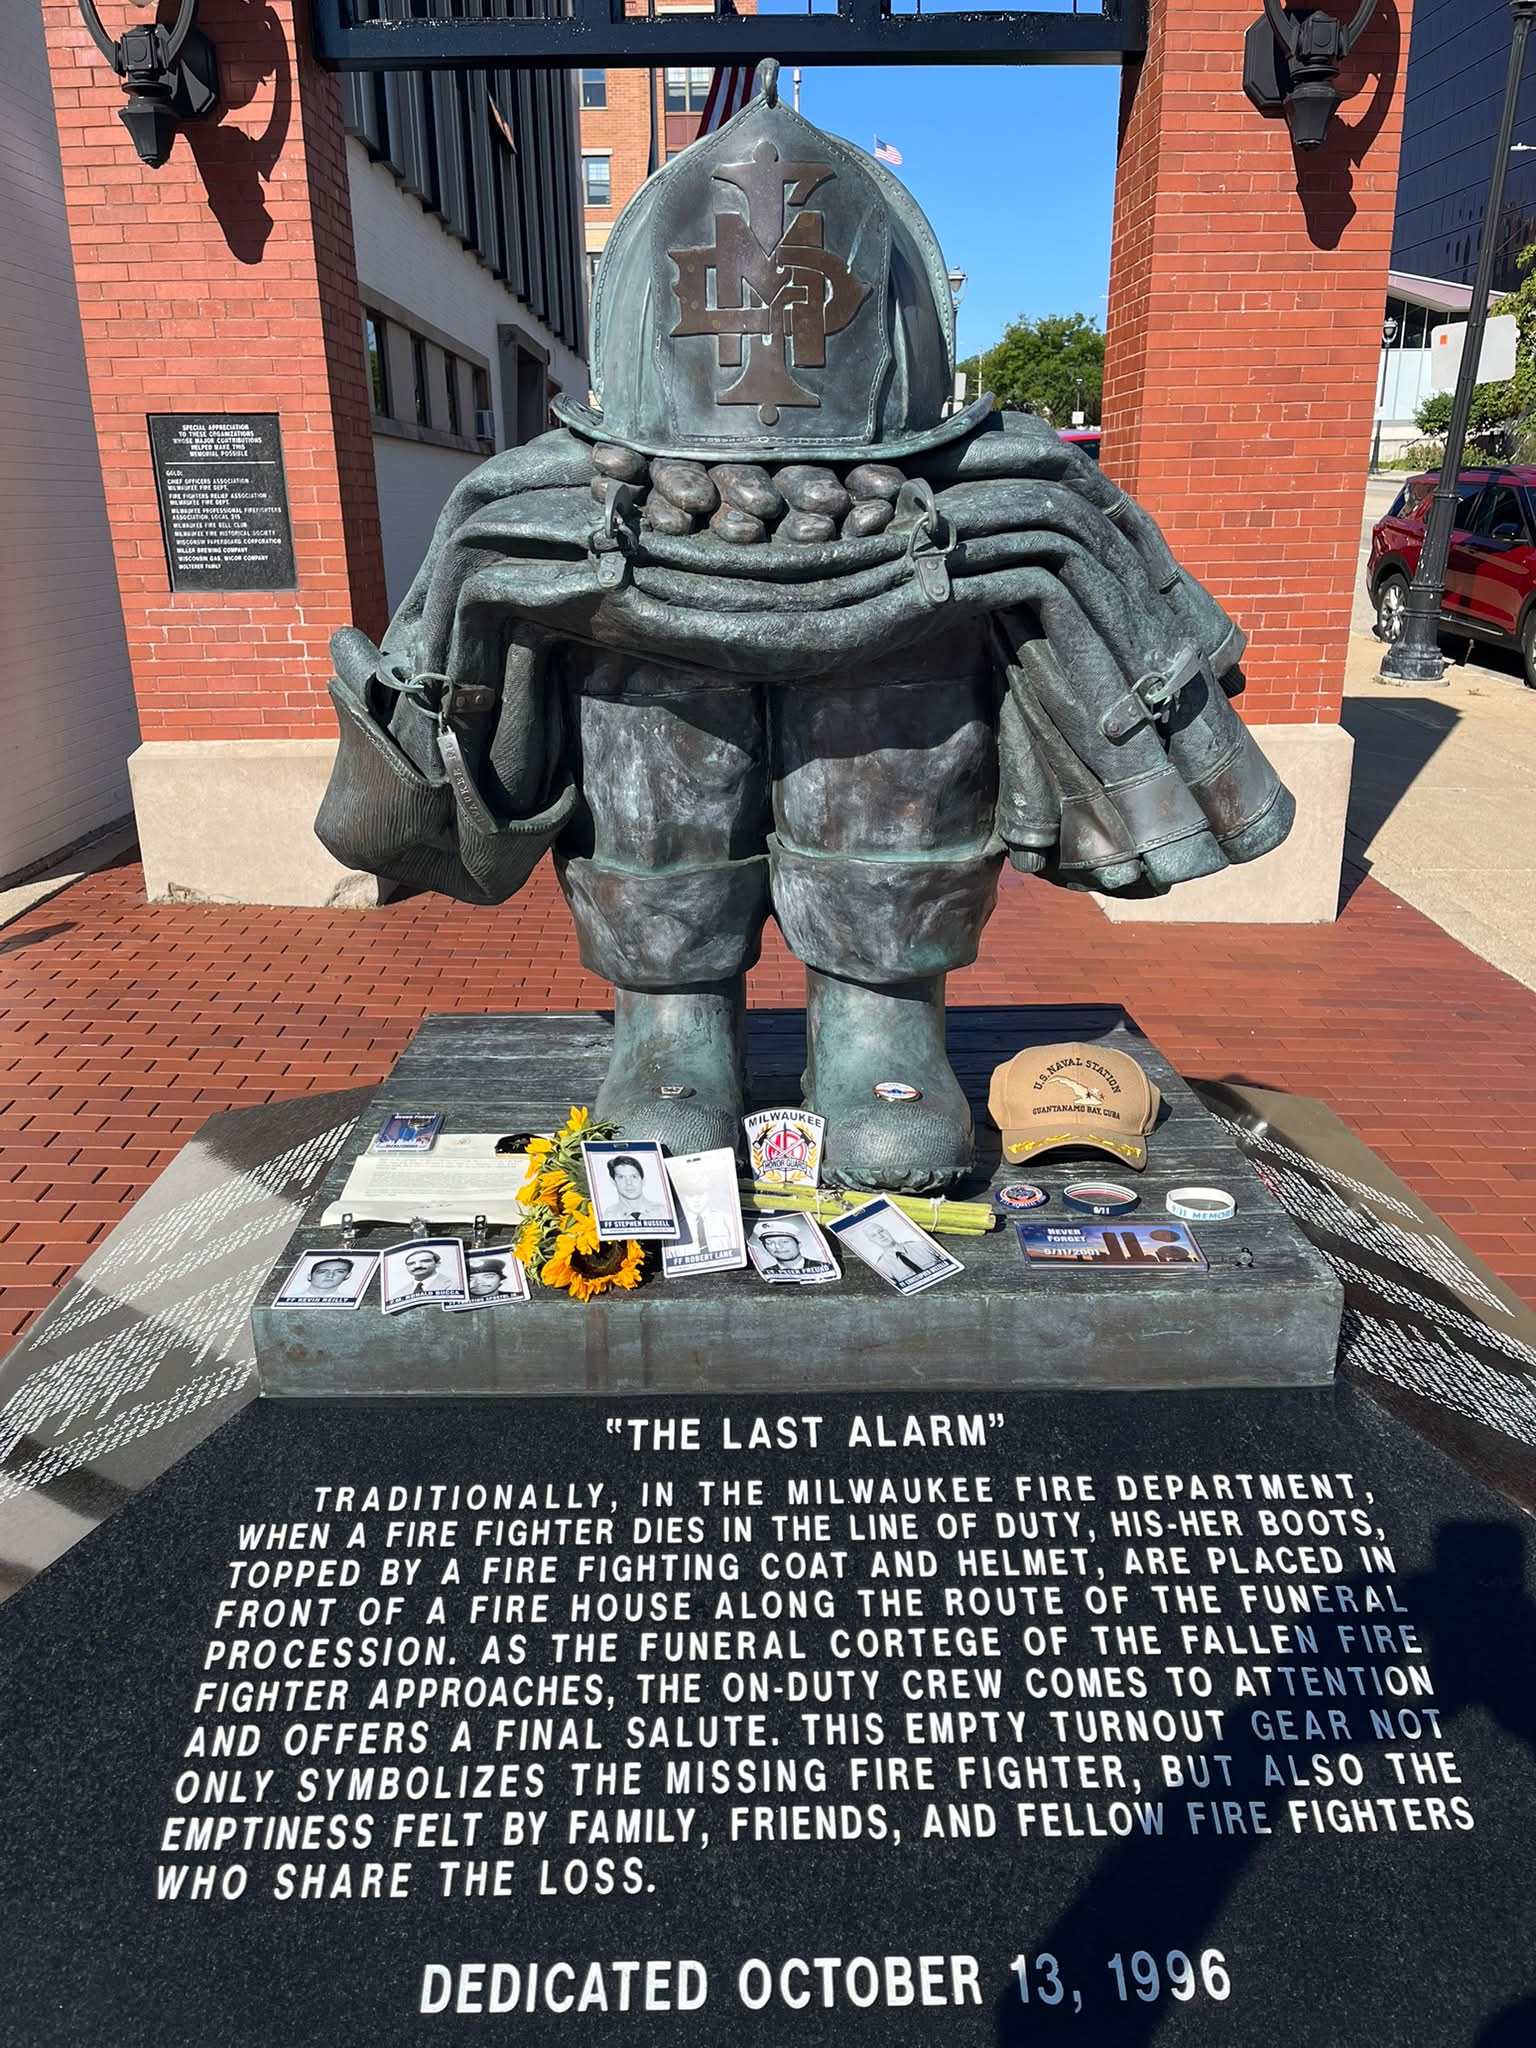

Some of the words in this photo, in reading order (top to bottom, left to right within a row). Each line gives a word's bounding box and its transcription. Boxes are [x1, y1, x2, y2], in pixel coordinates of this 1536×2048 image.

[1033, 1073, 1050, 1091] U.S.
[1049, 1058, 1083, 1076] NAVAL
[1085, 1059, 1121, 1094] STATION
[748, 1111, 822, 1128] MILWAUKEE
[1033, 1105, 1085, 1115] GUANTANAMO
[1103, 1109, 1120, 1120] CUBA
[764, 1160, 785, 1169] HONOR
[787, 1160, 806, 1170] GUARD
[1093, 1206, 1110, 1214] 9/11
[685, 1253, 713, 1264] ROBERT
[1043, 1248, 1100, 1256] 9/11/2001
[723, 1416, 823, 1449] LAST
[315, 1483, 617, 1513] TRADITIONALLY,
[642, 1482, 673, 1507] IN
[699, 1480, 763, 1506] THE
[788, 1477, 993, 1504] MILWAUKEE
[1016, 1476, 1095, 1501] FIRE
[1116, 1474, 1374, 1504] DEPARTMENT,
[238, 1523, 330, 1550] WHEN
[346, 1522, 365, 1548] A
[386, 1521, 458, 1547] FIRE
[475, 1519, 613, 1546] FIGHTER
[634, 1516, 704, 1543] DIES
[724, 1516, 751, 1542] IN
[771, 1515, 830, 1541] THE
[850, 1514, 918, 1540] LINE
[937, 1513, 976, 1539] OF
[996, 1512, 1095, 1543] DUTY,
[1110, 1510, 1243, 1537] HIS-HER
[1258, 1509, 1385, 1541] BOOTS,
[229, 1560, 360, 1588] TOPPED
[380, 1558, 421, 1585] BY
[441, 1558, 460, 1584] A
[482, 1556, 557, 1584] FIRE
[578, 1553, 738, 1582] FIGHTING
[761, 1551, 847, 1580] COAT
[871, 1550, 937, 1577] AND
[958, 1548, 1104, 1580] HELMET,
[1125, 1547, 1190, 1574] ARE
[1207, 1547, 1343, 1574] PLACED
[1360, 1546, 1396, 1573] IN
[215, 1598, 336, 1628] FRONT
[359, 1597, 405, 1626] OF
[426, 1596, 445, 1624] A
[470, 1595, 549, 1623] FIRE
[571, 1592, 690, 1622] HOUSE
[715, 1590, 834, 1619] ALONG
[857, 1589, 923, 1617] THE
[945, 1587, 1063, 1616] ROUTE
[1085, 1586, 1128, 1614] OF
[1151, 1585, 1221, 1613] THE
[1240, 1585, 1408, 1614] FUNERAL
[204, 1636, 456, 1670] PROCESSION.
[481, 1634, 526, 1664] AS
[552, 1633, 617, 1663] THE
[640, 1630, 806, 1661] FUNERAL
[830, 1627, 1001, 1658] CORTEGE
[1024, 1626, 1067, 1656] OF
[1091, 1626, 1161, 1655] THE
[1181, 1625, 1318, 1654] FALLEN
[1338, 1625, 1422, 1653] FIRE
[194, 1680, 348, 1713] FIGHTER
[368, 1674, 614, 1711] APPROACHES,
[637, 1673, 701, 1704] THE
[723, 1670, 879, 1702] ON-DUTY
[902, 1669, 1001, 1700] CREW
[1026, 1666, 1147, 1698] COMES
[1165, 1666, 1212, 1697] TO
[1236, 1665, 1434, 1696] ATTENTION
[184, 1725, 260, 1757] AND
[284, 1720, 428, 1756] OFFERS
[450, 1721, 471, 1752] A
[496, 1718, 602, 1751] FINAL
[626, 1715, 778, 1749] SALUTE.
[801, 1712, 884, 1745] THIS
[906, 1711, 1025, 1743] EMPTY
[1050, 1710, 1224, 1743] TURNOUT
[1252, 1710, 1352, 1740] GEAR
[1370, 1709, 1442, 1739] NOT
[175, 1770, 274, 1804] ONLY
[297, 1763, 544, 1802] SYMBOLIZES
[571, 1762, 641, 1796] THE
[667, 1759, 826, 1794] MISSING
[851, 1757, 934, 1791] FIRE
[958, 1755, 1141, 1795] FIGHTER,
[1161, 1755, 1232, 1787] BUT
[1266, 1753, 1363, 1786] ALSO
[1384, 1752, 1462, 1784] THE
[161, 1814, 374, 1851] EMPTINESS
[394, 1812, 483, 1847] FELT
[504, 1811, 547, 1845] BY
[569, 1808, 708, 1849] FAMILY,
[731, 1804, 900, 1846] FRIENDS,
[923, 1803, 996, 1838] AND
[1017, 1802, 1163, 1837] FELLOW
[1187, 1802, 1272, 1834] FIRE
[1288, 1796, 1474, 1833] FIGHTERS
[157, 1864, 247, 1900] WHO
[274, 1863, 412, 1900] SHARE
[440, 1860, 514, 1896] THE
[540, 1857, 655, 1895] LOSS.
[420, 1960, 707, 2013] DEDICATED
[738, 1955, 983, 2010] OCTOBER
[1010, 1953, 1081, 2013] 13,
[1108, 1948, 1230, 2002] 1996
